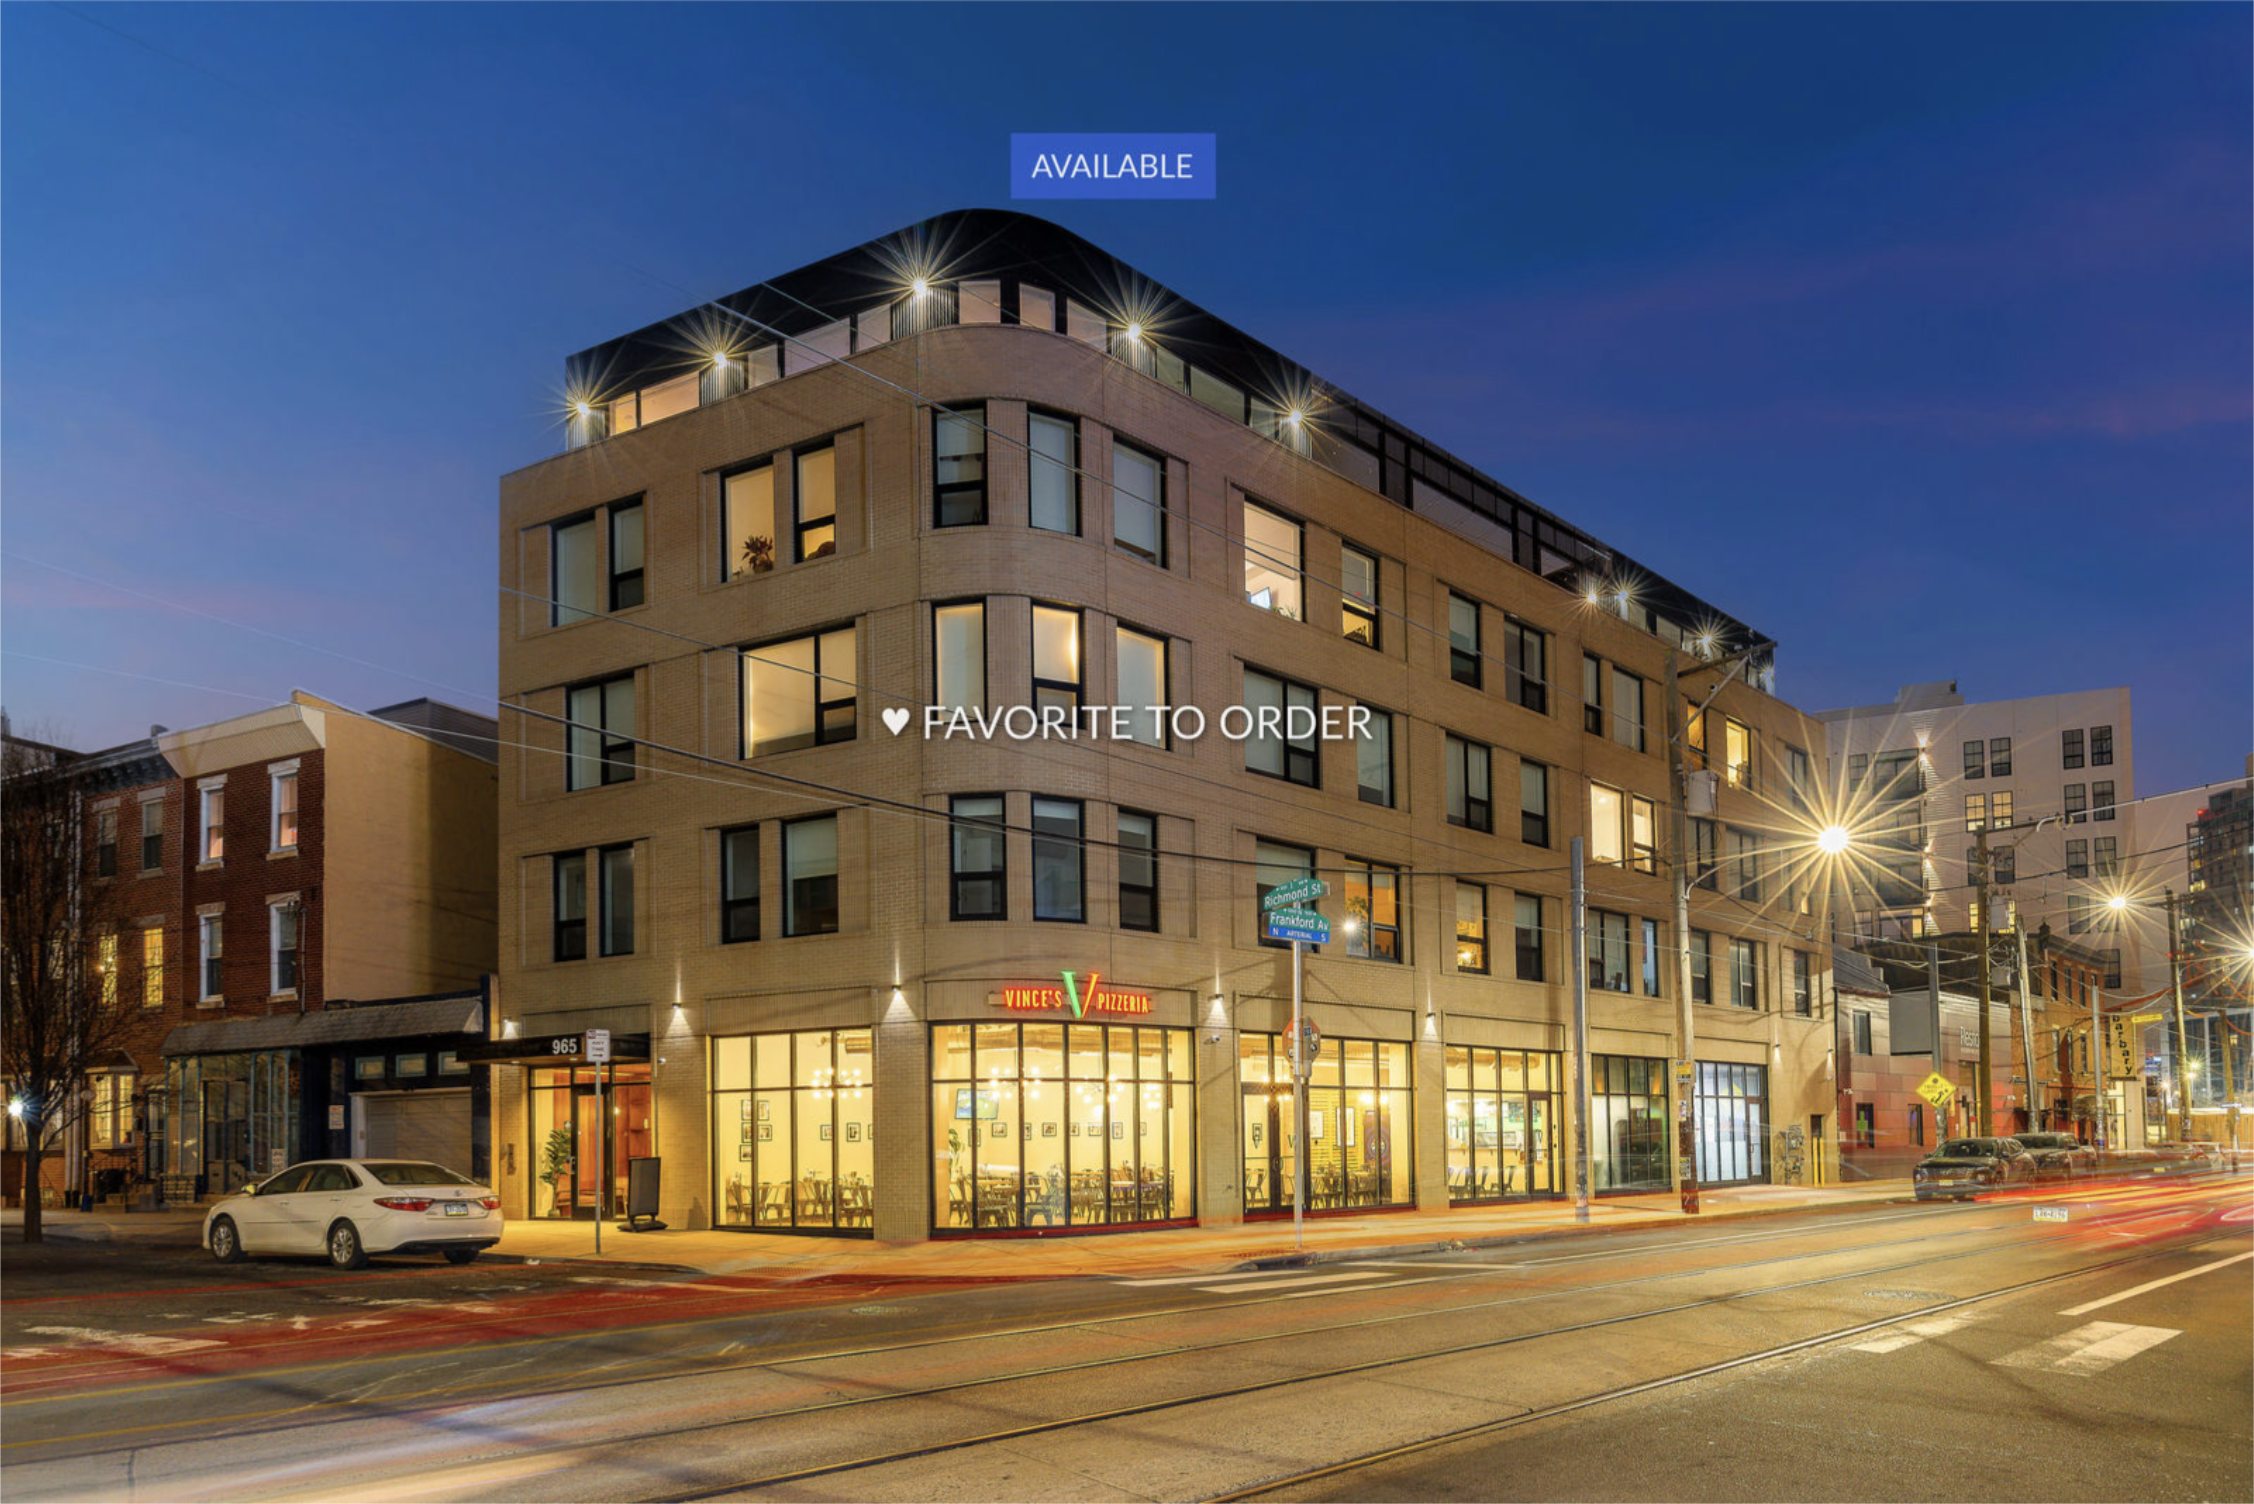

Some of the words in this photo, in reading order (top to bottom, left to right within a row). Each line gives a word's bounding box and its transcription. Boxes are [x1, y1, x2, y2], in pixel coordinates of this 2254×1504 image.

[1264, 885, 1309, 909] Richmond
[1311, 882, 1321, 896] St
[1270, 911, 1315, 930] Frankford
[1317, 919, 1329, 931] Av
[1272, 926, 1280, 936] N
[1287, 929, 1313, 940] ARTERIAL
[1321, 932, 1328, 942] S
[1004, 988, 1063, 1009] VINCE'S
[1061, 970, 1100, 1020] V
[1098, 992, 1149, 1014] PIZZERIA
[552, 1038, 578, 1055] 965
